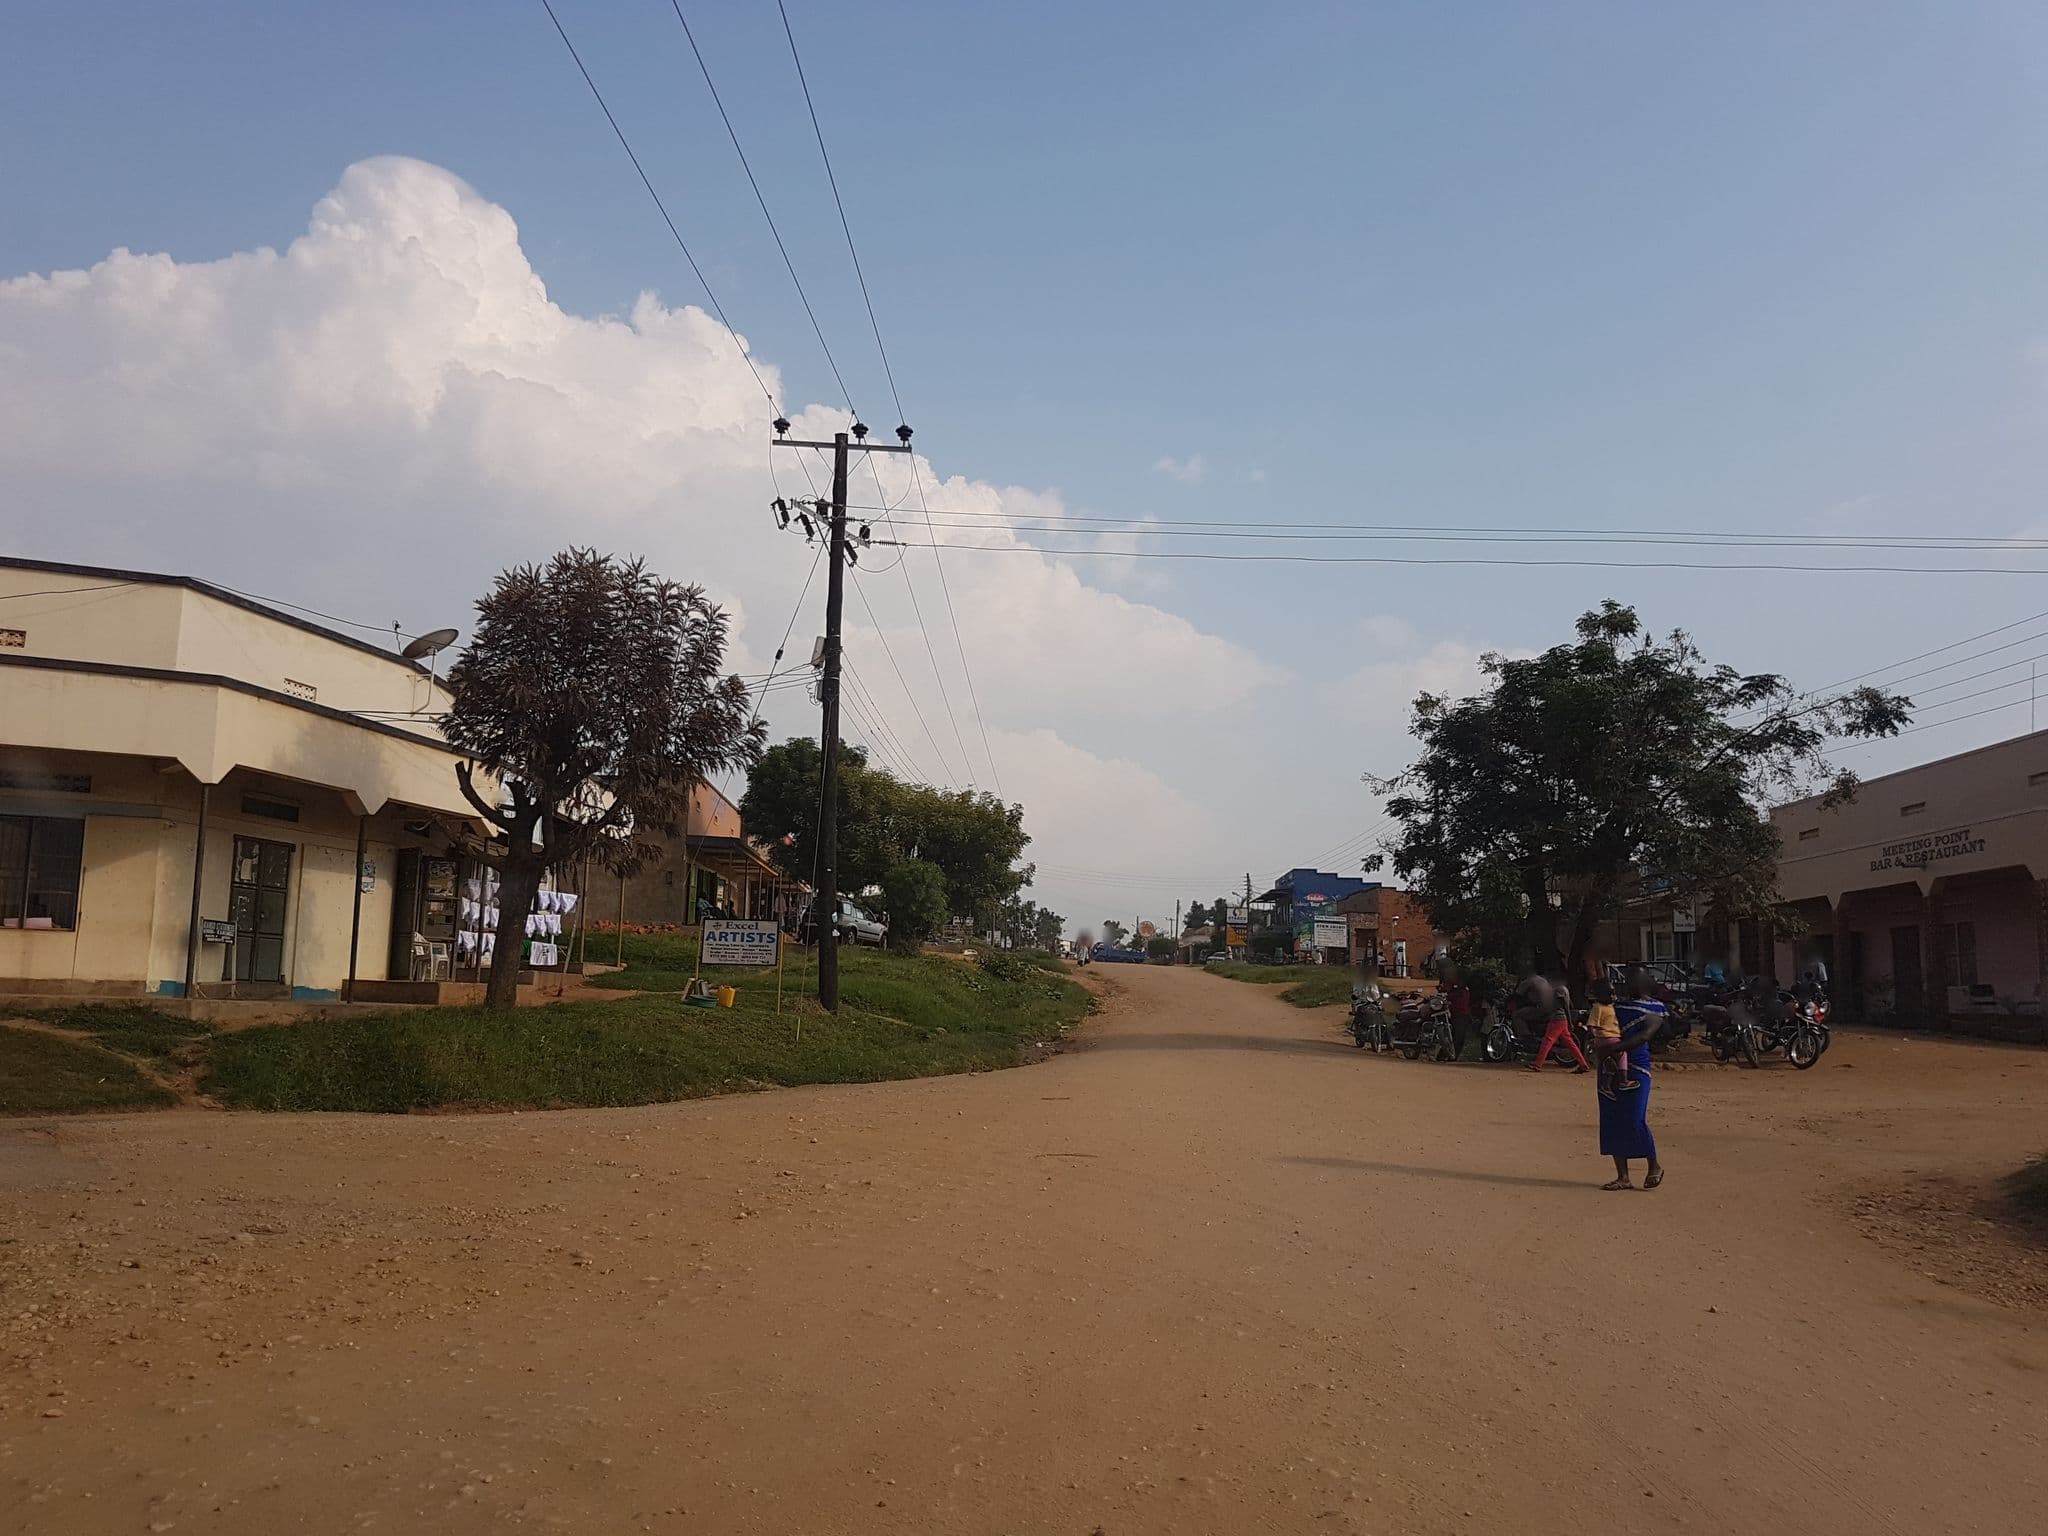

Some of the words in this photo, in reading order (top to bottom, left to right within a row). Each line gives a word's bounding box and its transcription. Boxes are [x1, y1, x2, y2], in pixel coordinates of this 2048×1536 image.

[1882, 838, 1931, 857] MEETING
[1934, 829, 1970, 847] POINT
[1870, 858, 1892, 872] BAR
[1894, 857, 1904, 867] &
[1905, 839, 1985, 863] RESTAURANT
[726, 922, 759, 930] Excel
[706, 931, 776, 943] ARTISTS
